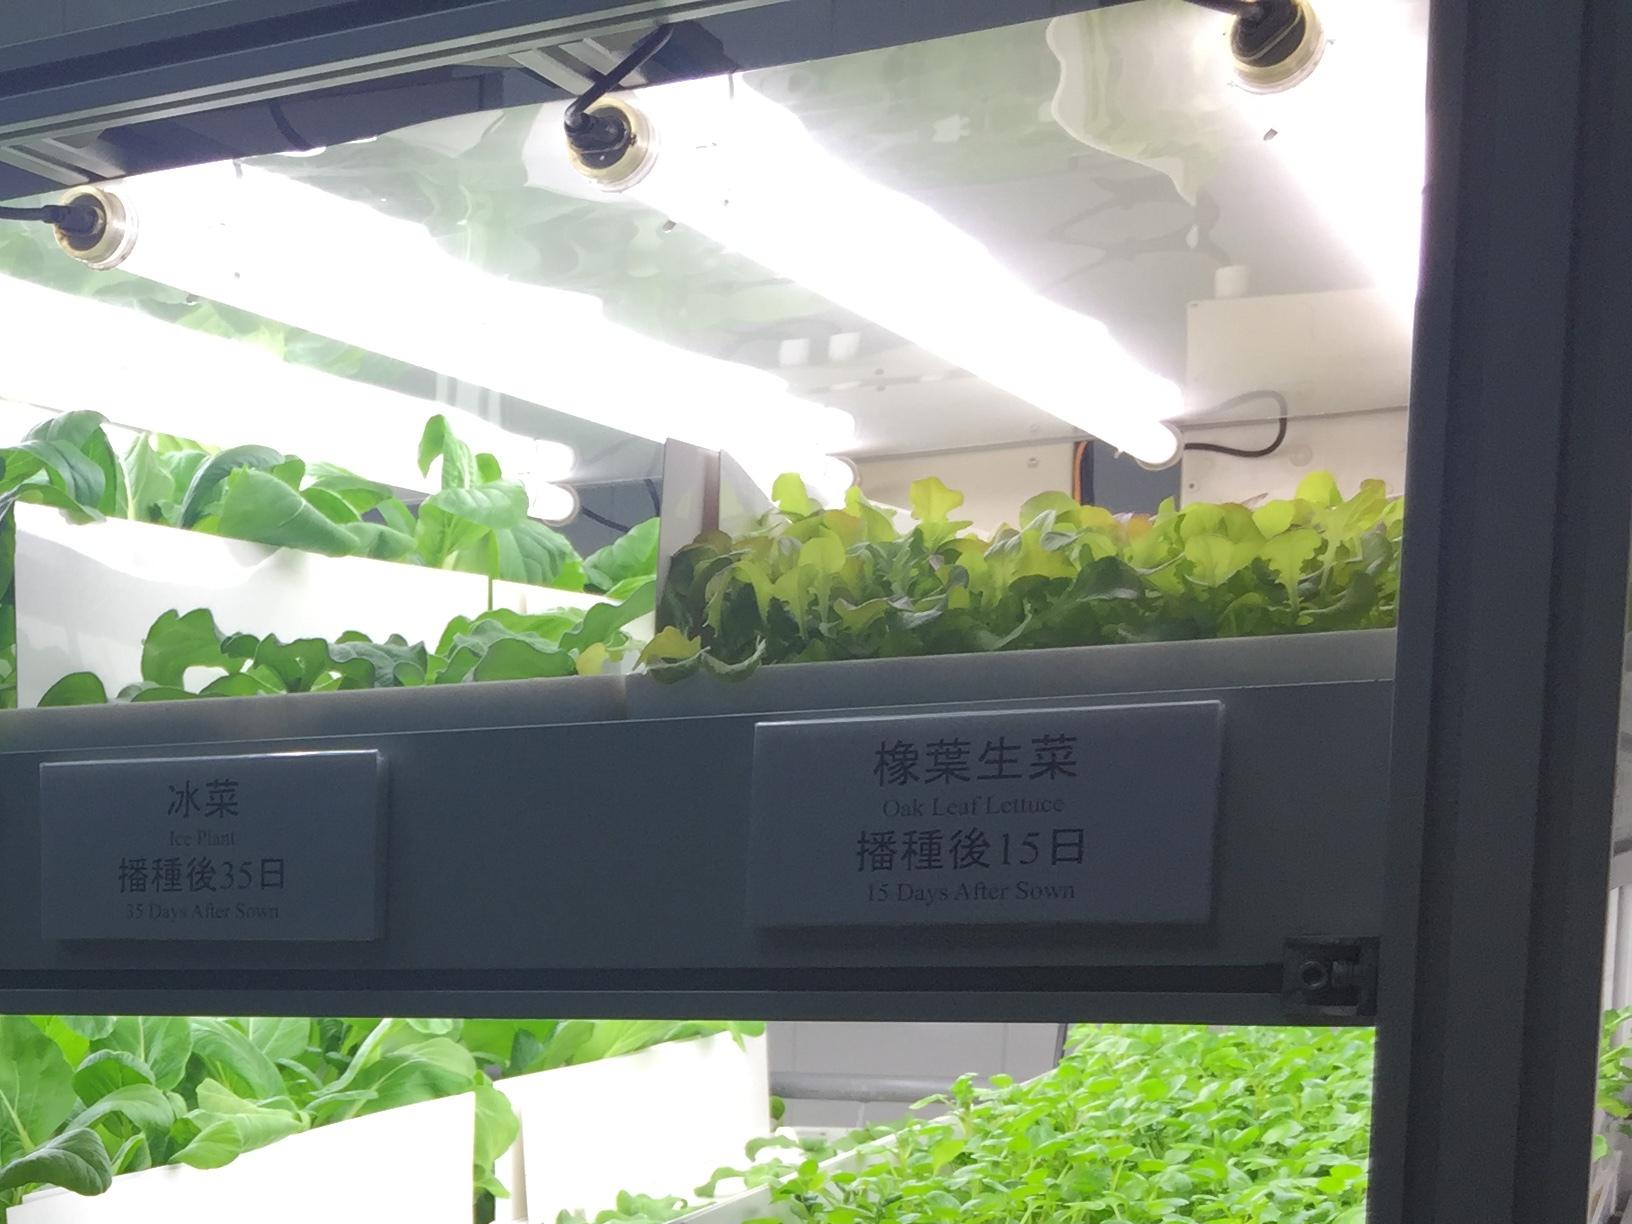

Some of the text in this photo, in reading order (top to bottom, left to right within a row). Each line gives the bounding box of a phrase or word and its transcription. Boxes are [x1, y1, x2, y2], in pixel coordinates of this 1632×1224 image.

[873, 733, 1079, 788] 橡葉生菜
[166, 777, 240, 818] 冰菜
[882, 795, 1066, 818] Oak Leaf Lettuce
[168, 828, 236, 848] Ice Plant
[856, 826, 1085, 873] 播種後15日
[117, 855, 286, 894] 播種後35日
[866, 879, 1076, 907] 15 Days After Sown
[126, 901, 280, 923] 35 Days After Sown
